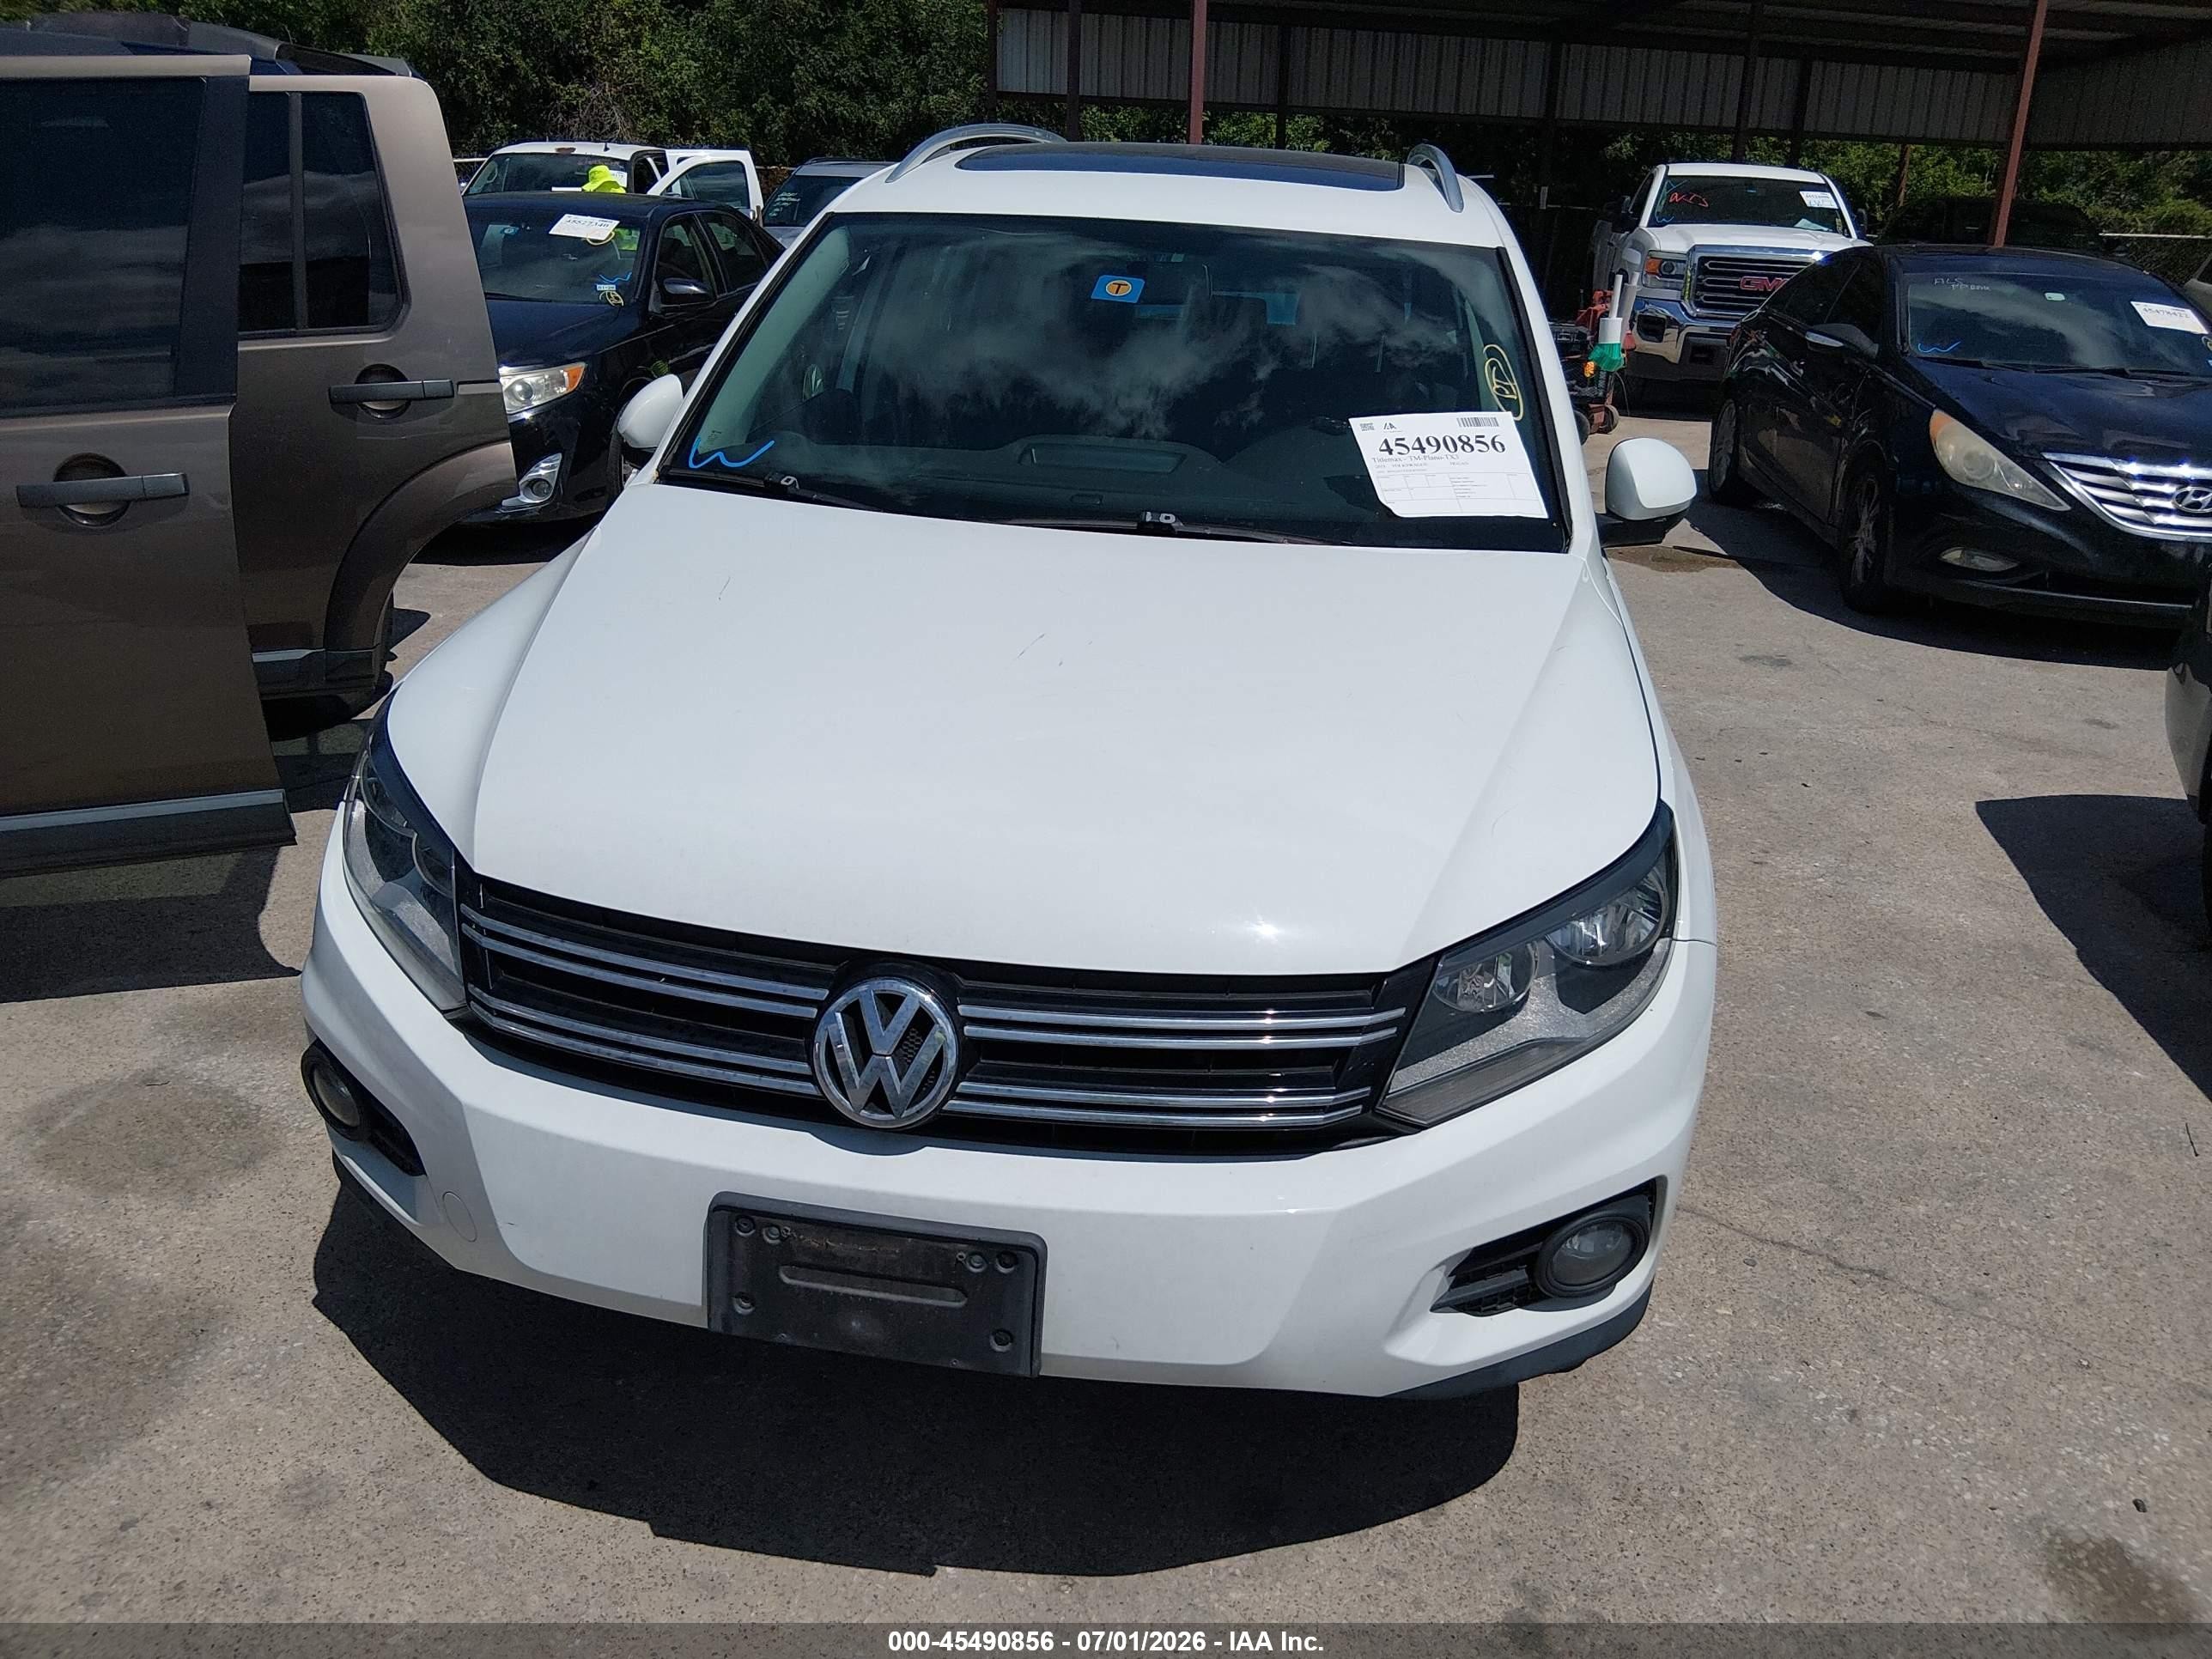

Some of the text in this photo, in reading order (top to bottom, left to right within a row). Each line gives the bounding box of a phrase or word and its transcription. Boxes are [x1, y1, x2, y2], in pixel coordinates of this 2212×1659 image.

[1113, 283, 1127, 295] T
[1740, 276, 1788, 292] GM
[1378, 434, 1506, 456] 45490856
[824, 987, 948, 1120] VW
